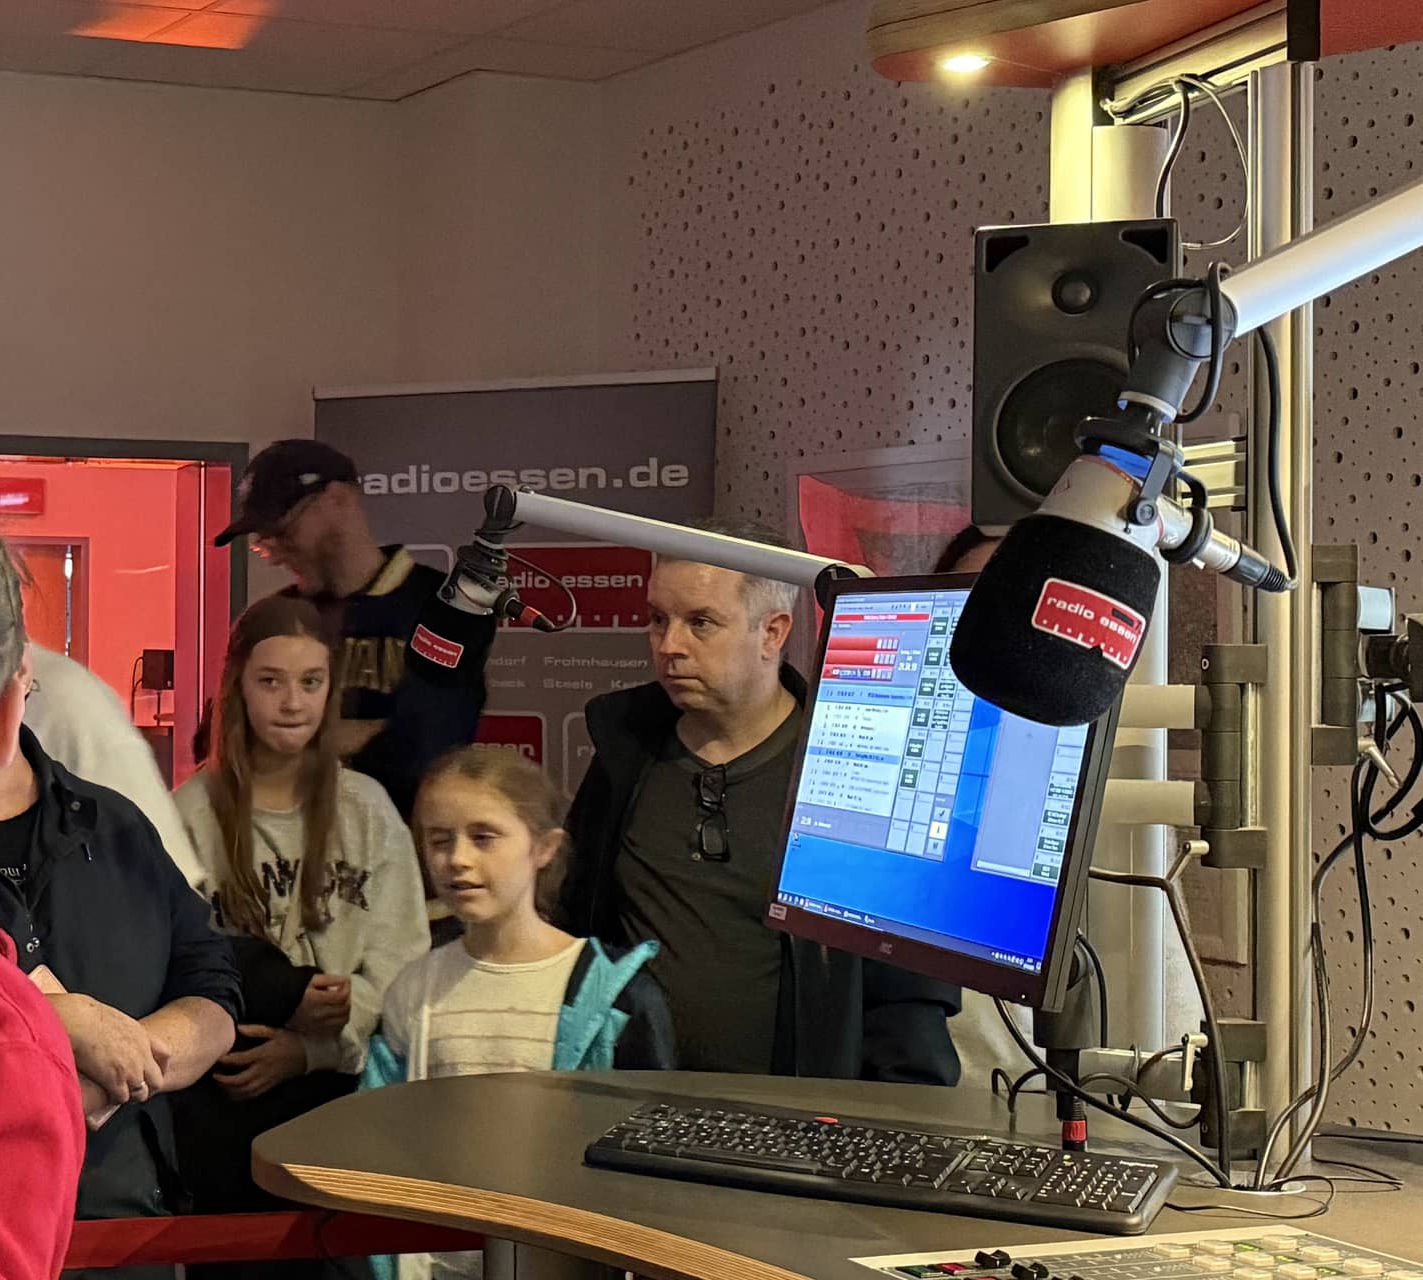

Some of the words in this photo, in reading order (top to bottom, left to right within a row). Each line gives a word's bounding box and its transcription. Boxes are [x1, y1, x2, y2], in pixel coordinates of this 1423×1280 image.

[358, 457, 689, 495] adioessen.de
[496, 571, 551, 589] adio
[561, 574, 644, 589] essen
[1046, 597, 1095, 620] radio
[1099, 616, 1138, 645] essen
[543, 656, 648, 669] Frohnhausen
[543, 678, 594, 690] Steele
